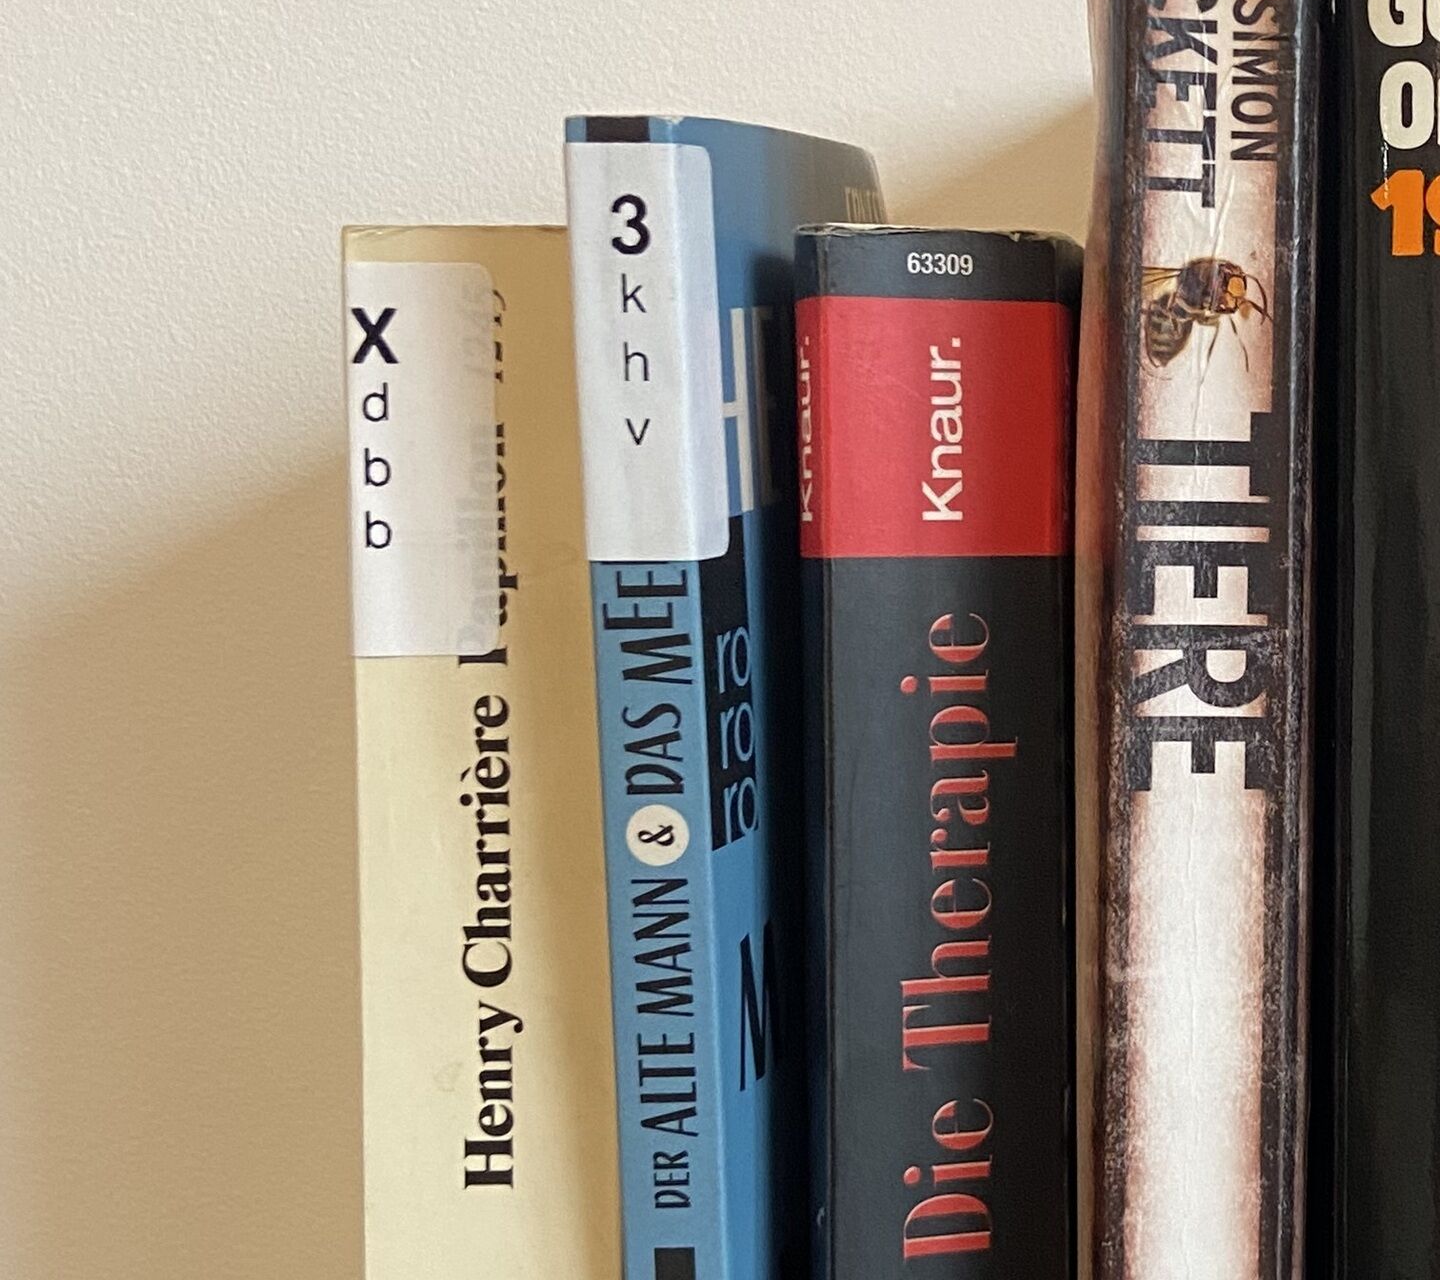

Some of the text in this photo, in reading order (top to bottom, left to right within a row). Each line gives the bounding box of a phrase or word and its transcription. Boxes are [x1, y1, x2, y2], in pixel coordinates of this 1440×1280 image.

[611, 194, 650, 255] 3
[906, 252, 974, 277] 63309
[622, 275, 647, 314] k
[362, 384, 389, 422] d
[623, 342, 649, 382] h
[363, 448, 392, 487] b
[921, 336, 965, 522] Knaur.
[365, 513, 392, 549] b
[602, 560, 692, 685] MEE
[1131, 412, 1272, 790] TIERE
[623, 703, 684, 796] DAS
[459, 693, 514, 988] Charrière
[630, 878, 696, 1016] MANN
[900, 611, 1018, 1260] Die Therapie
[463, 1001, 524, 1190] Henry
[638, 1032, 700, 1138] ALTE
[653, 1150, 692, 1210] DER
